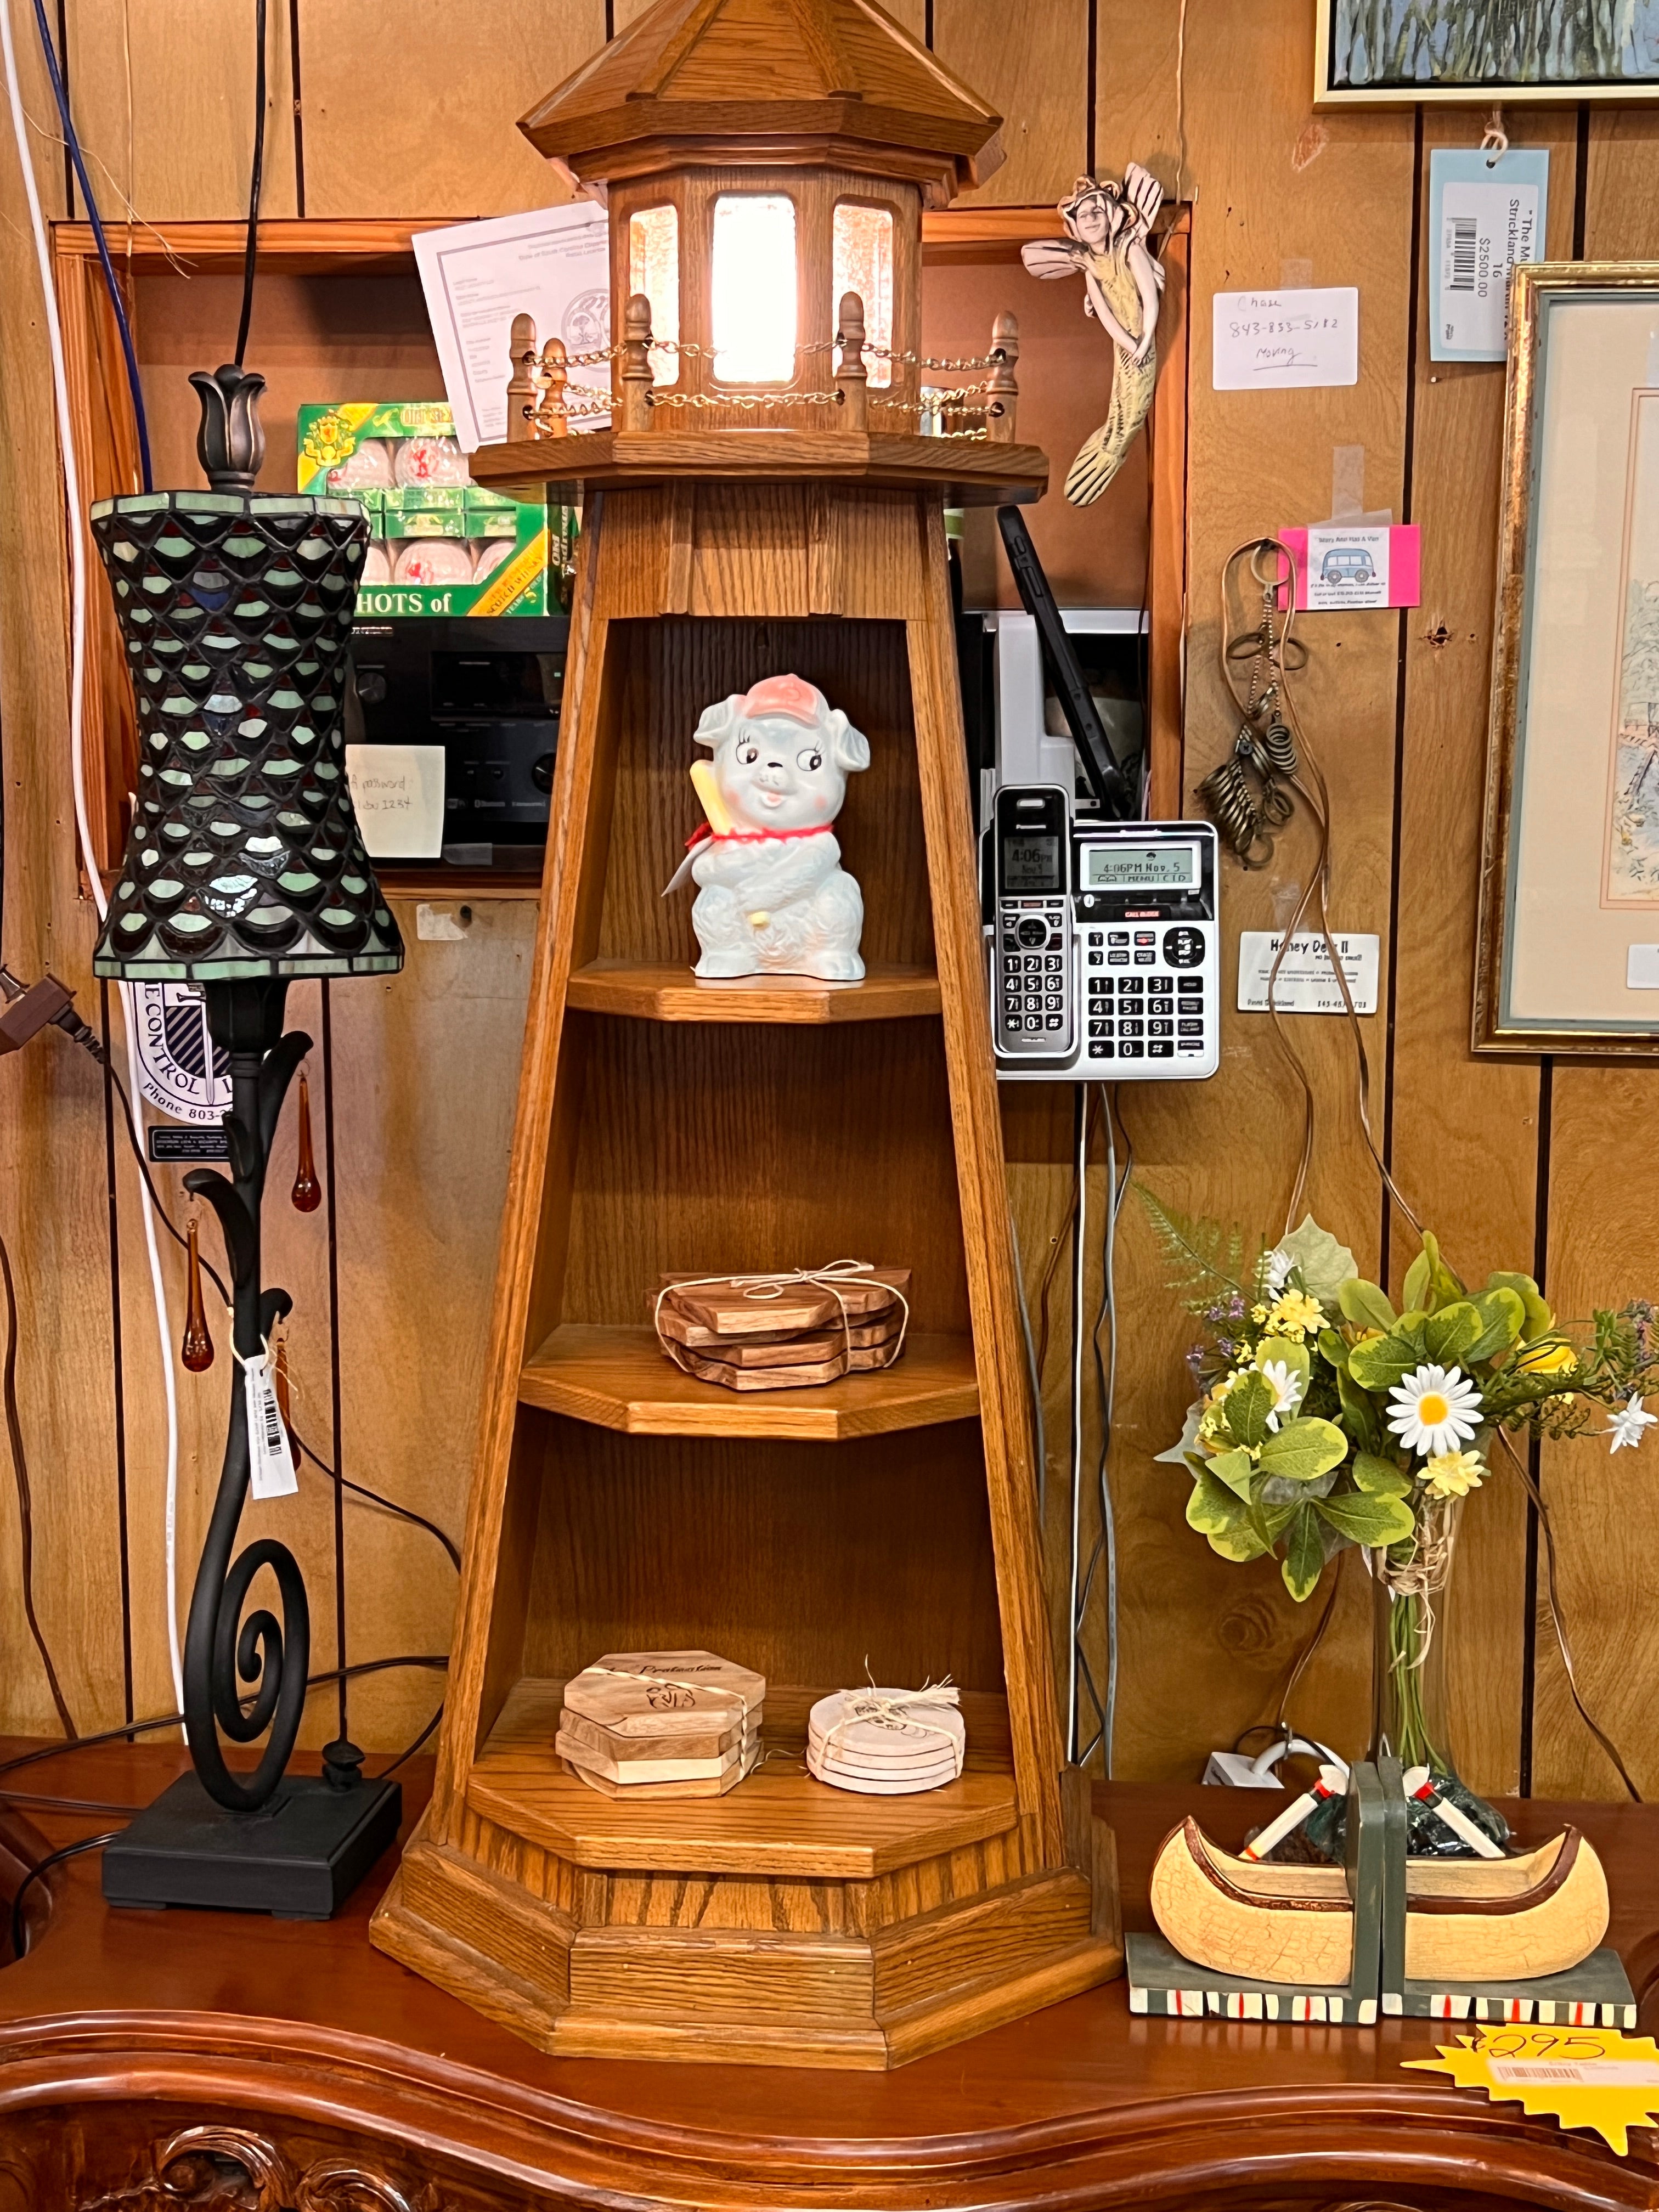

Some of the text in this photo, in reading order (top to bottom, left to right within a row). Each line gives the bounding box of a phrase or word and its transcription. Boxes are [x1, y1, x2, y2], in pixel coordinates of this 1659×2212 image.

[1506, 199, 1520, 264] Strickland
[1521, 218, 1533, 242] The
[1477, 238, 1491, 298] $2500.00
[1492, 263, 1503, 278] 16
[431, 592, 452, 613] of
[1104, 863, 1142, 873] 4:06PM
[1173, 862, 1180, 872] 5
[1271, 939, 1310, 955] Hney
[1007, 957, 1056, 971] 1 2 3
[1006, 977, 1056, 991] 4 5 6
[1094, 979, 1161, 992] 1 2 3
[1007, 996, 1056, 1011] 7 8 9
[1093, 999, 1162, 1013] 4 5 6
[1026, 1017, 1036, 1030] 0
[1093, 1021, 1162, 1035] 7 8 9
[145, 1003, 200, 1094] CONTROL
[1123, 1042, 1133, 1056] 0
[143, 1082, 183, 1114] Phone
